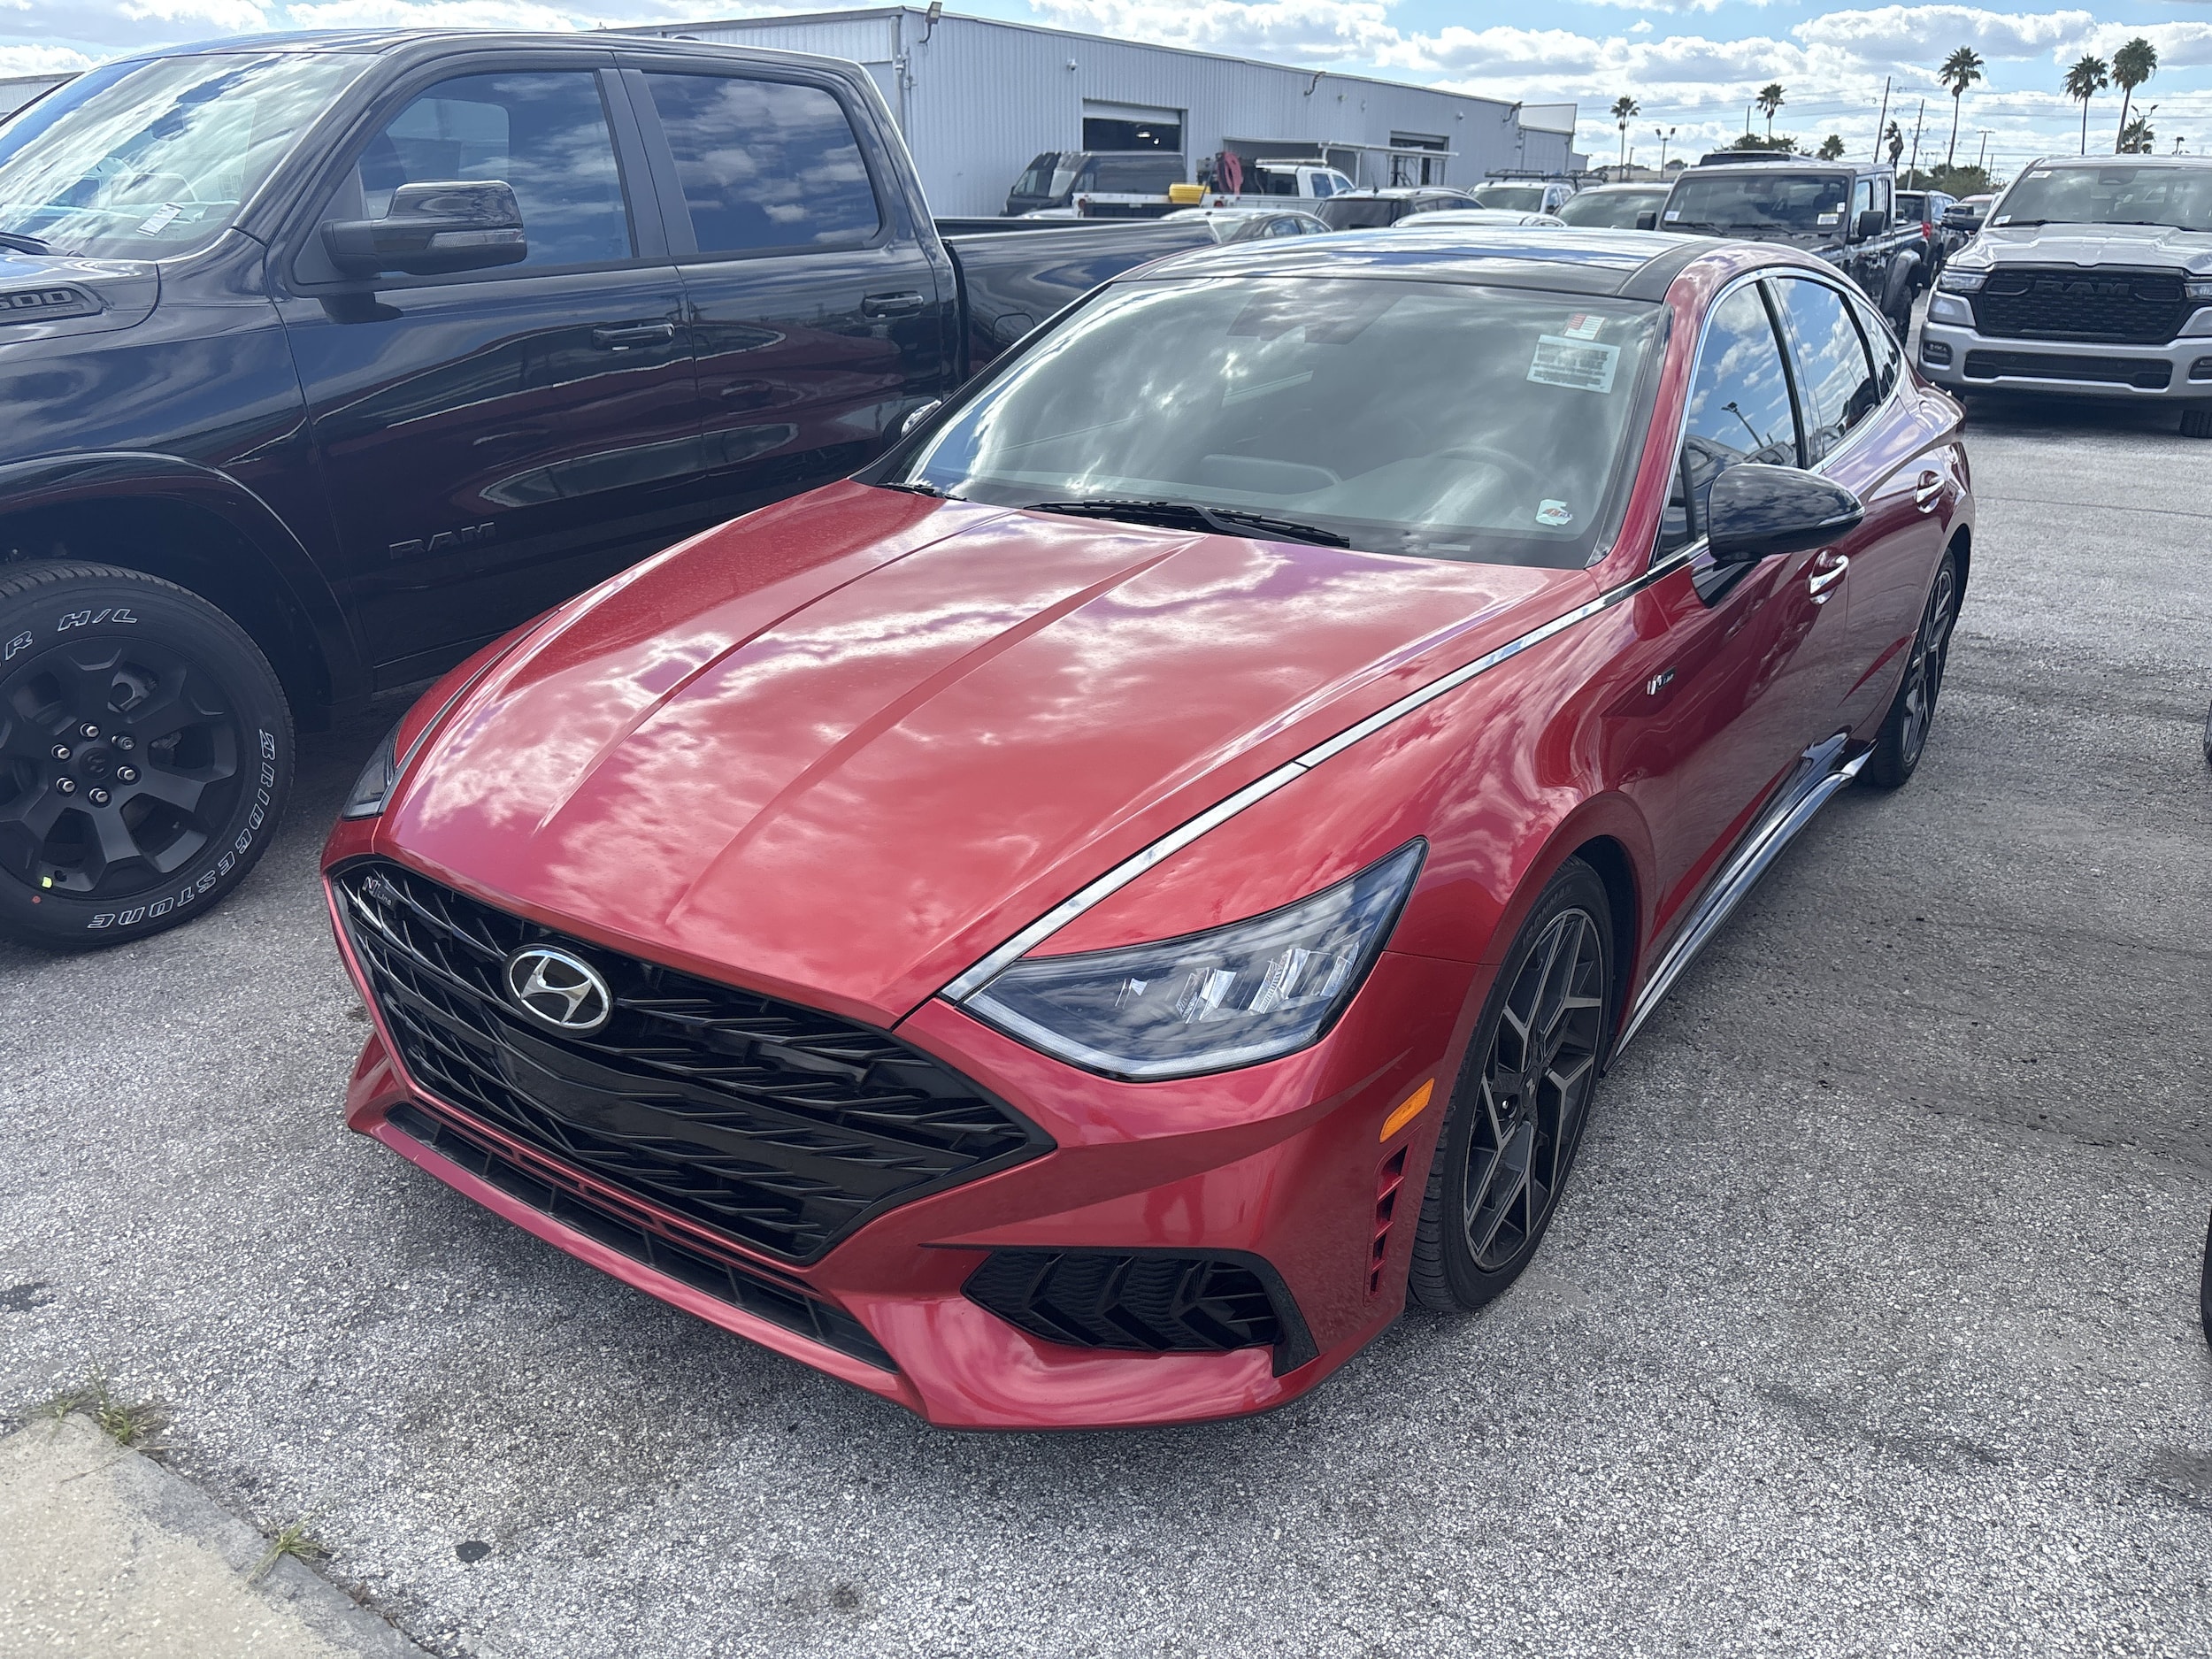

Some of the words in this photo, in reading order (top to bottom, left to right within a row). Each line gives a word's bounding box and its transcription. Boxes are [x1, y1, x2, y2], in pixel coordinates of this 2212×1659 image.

[2032, 279, 2131, 294] RAM
[388, 521, 497, 559] RAM
[57, 608, 139, 633] H/L
[87, 729, 276, 930] BRIDGESTONE
[362, 876, 381, 897] N
[377, 890, 392, 906] Line
